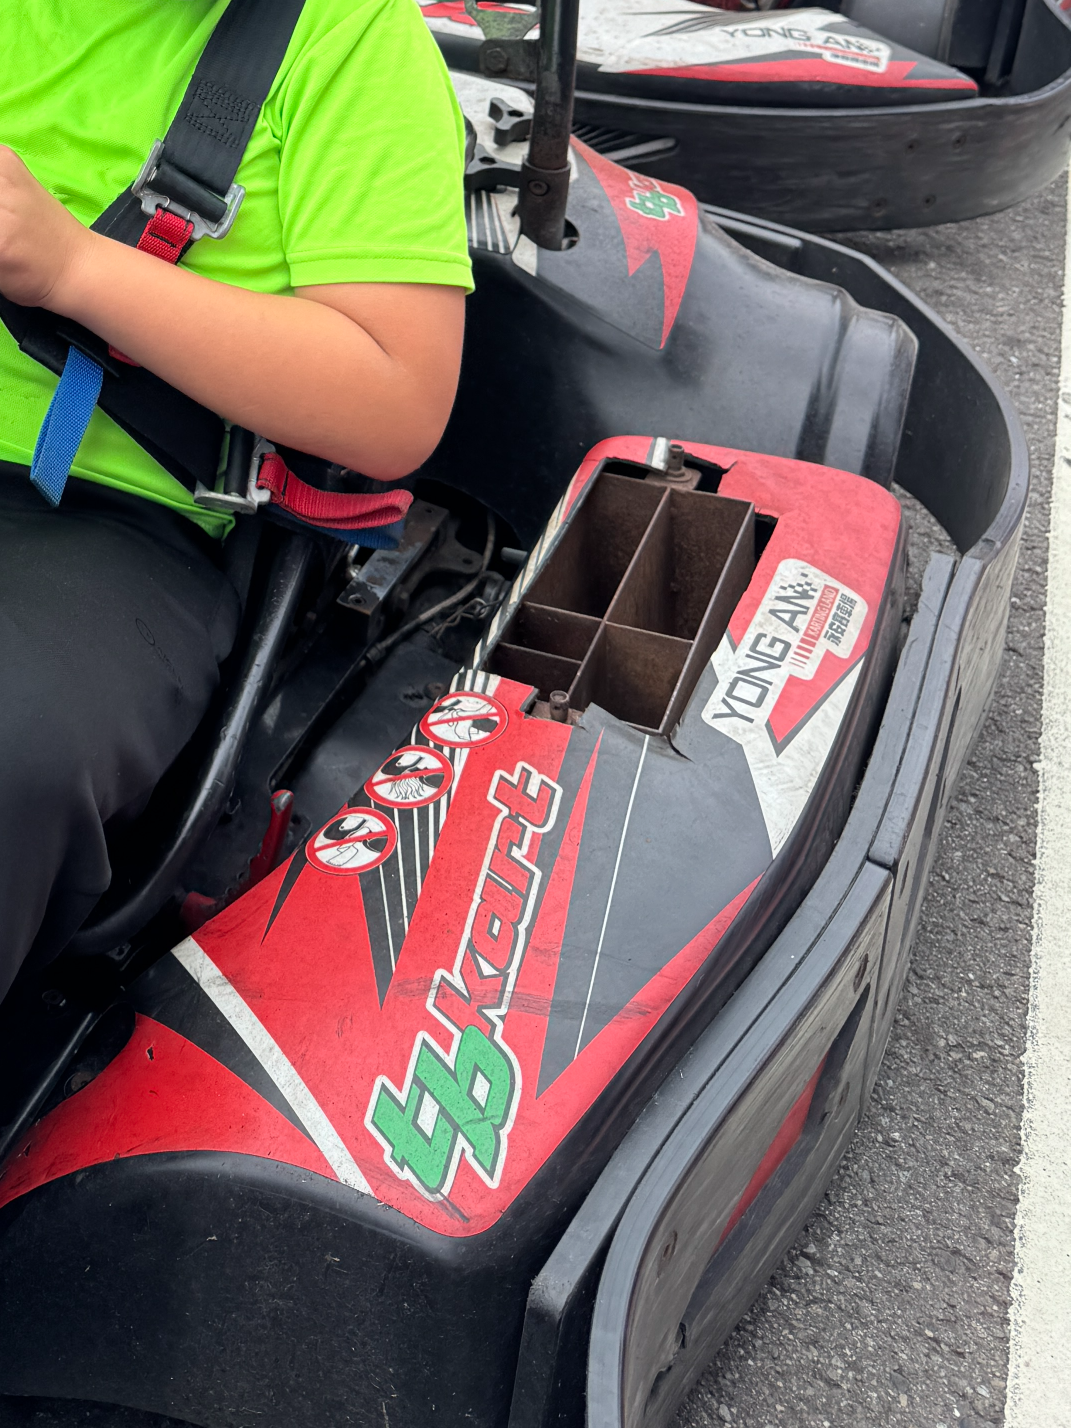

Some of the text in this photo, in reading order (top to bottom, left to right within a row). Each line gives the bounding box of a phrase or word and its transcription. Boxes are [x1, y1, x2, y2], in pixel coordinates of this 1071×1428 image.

[721, 26, 811, 43] YONG
[808, 588, 837, 637] KARTING LAND
[823, 592, 857, 647] 永安賽車場
[711, 632, 792, 724] YONG
